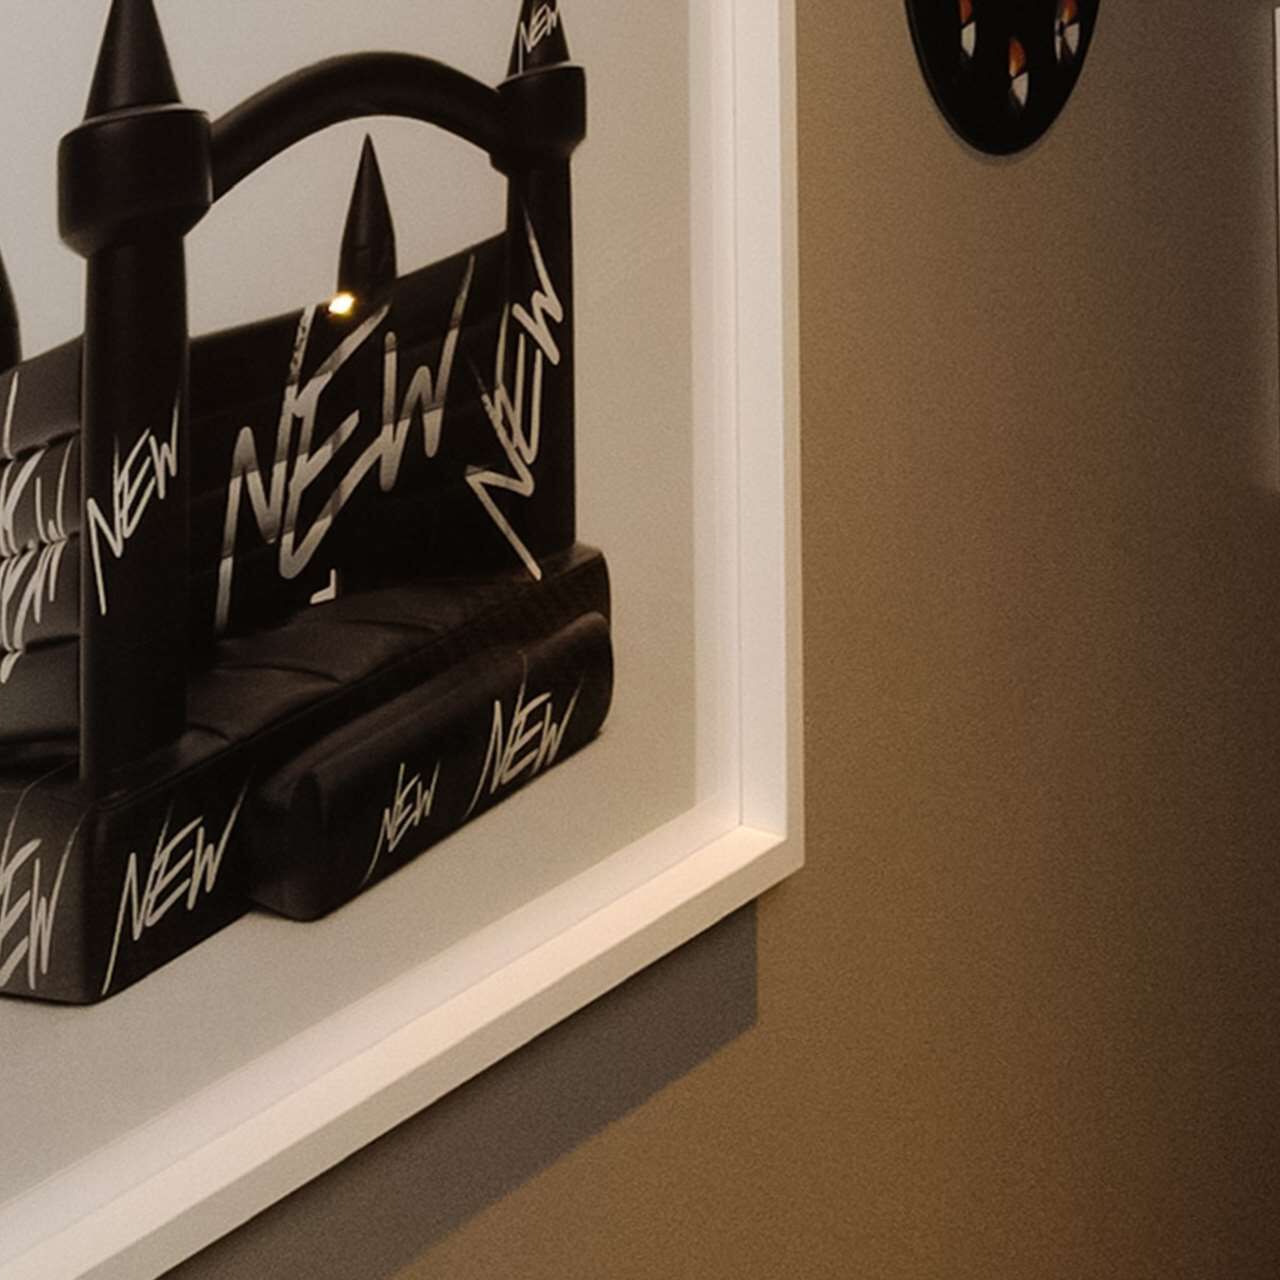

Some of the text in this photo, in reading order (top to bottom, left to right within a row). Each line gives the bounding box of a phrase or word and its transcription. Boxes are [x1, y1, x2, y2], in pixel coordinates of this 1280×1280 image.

[215, 252, 476, 632] NEW
[464, 202, 565, 582] NEW
[86, 395, 181, 618] NEW
[358, 760, 441, 889] NEW
[463, 655, 585, 822] NEW
[100, 778, 250, 997] NEW
